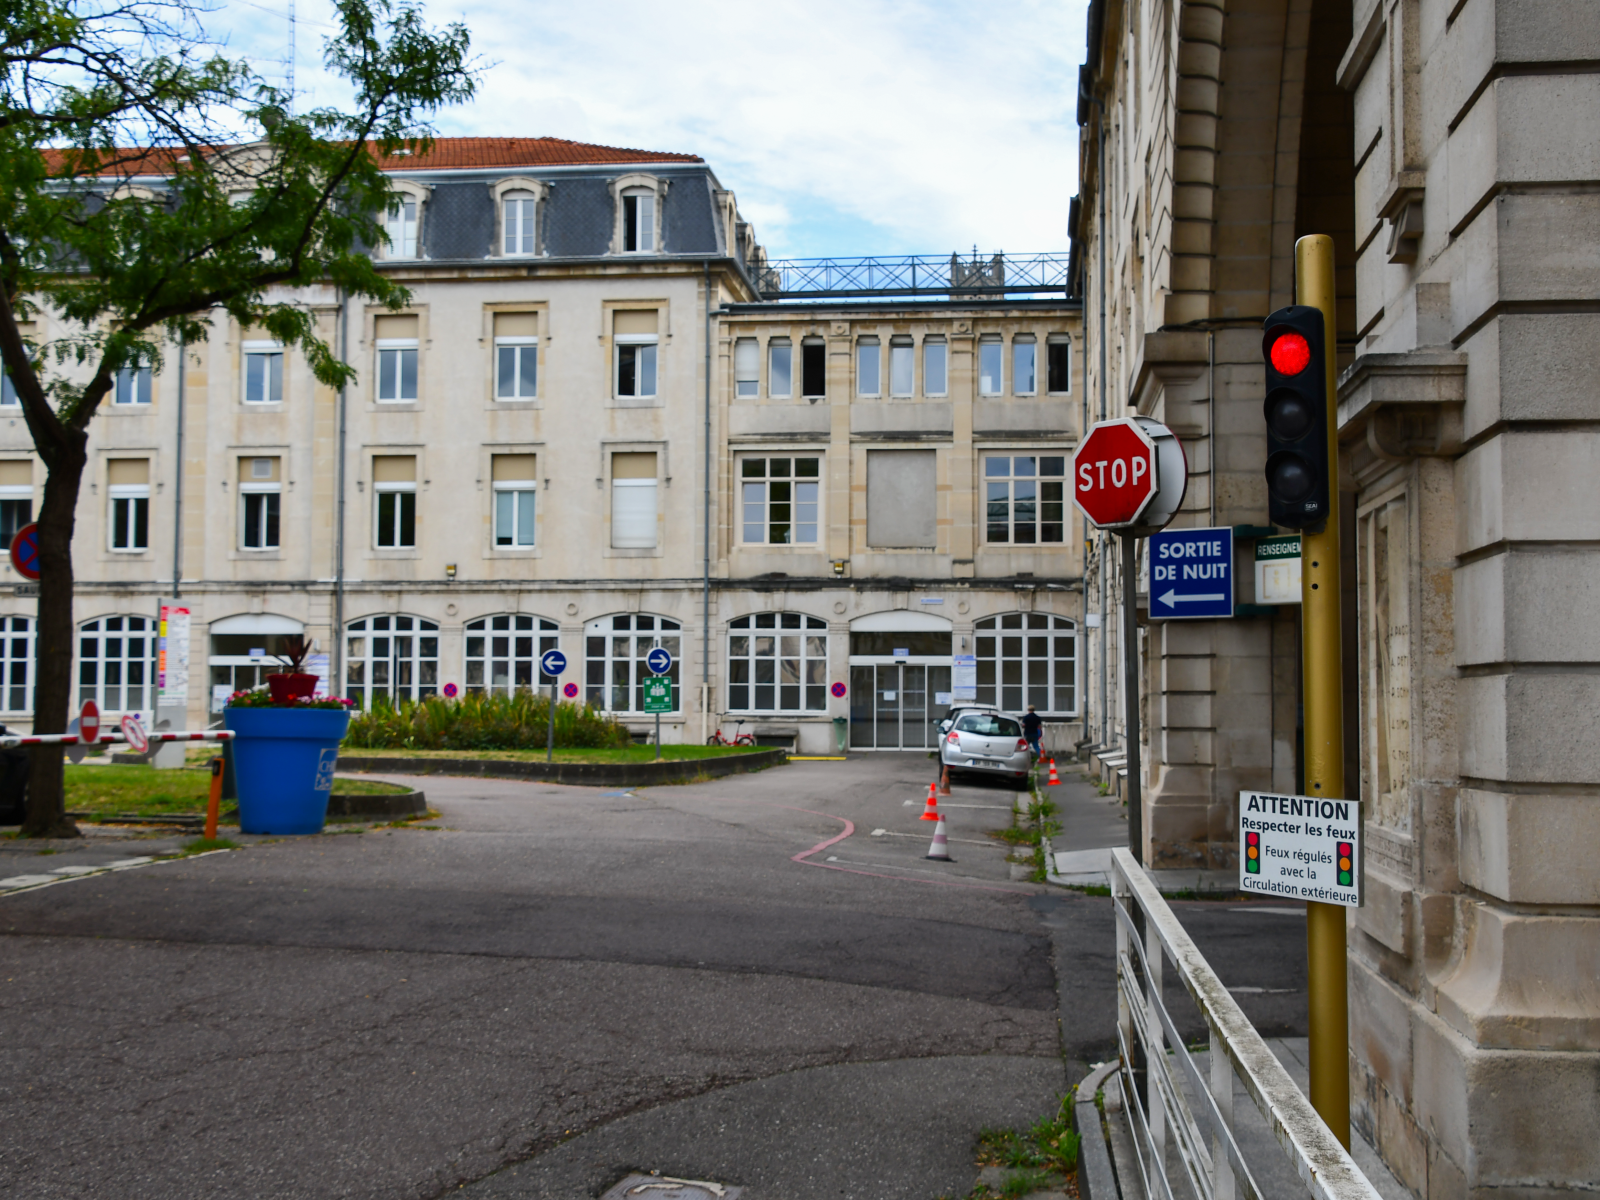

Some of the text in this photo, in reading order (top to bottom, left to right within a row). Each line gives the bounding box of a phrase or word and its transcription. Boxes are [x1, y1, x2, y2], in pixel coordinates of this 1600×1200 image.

[1078, 456, 1147, 492] STOP
[1159, 541, 1222, 559] SORTIE
[1154, 563, 1227, 581] DE NUIT
[17, 585, 40, 595] SAU
[1247, 795, 1349, 821] ATTENTION
[1241, 817, 1356, 840] Respecter les feux
[1265, 845, 1332, 864] Feux régulés
[1280, 867, 1317, 879] avec la
[1243, 876, 1357, 903] Circulation extérieure
